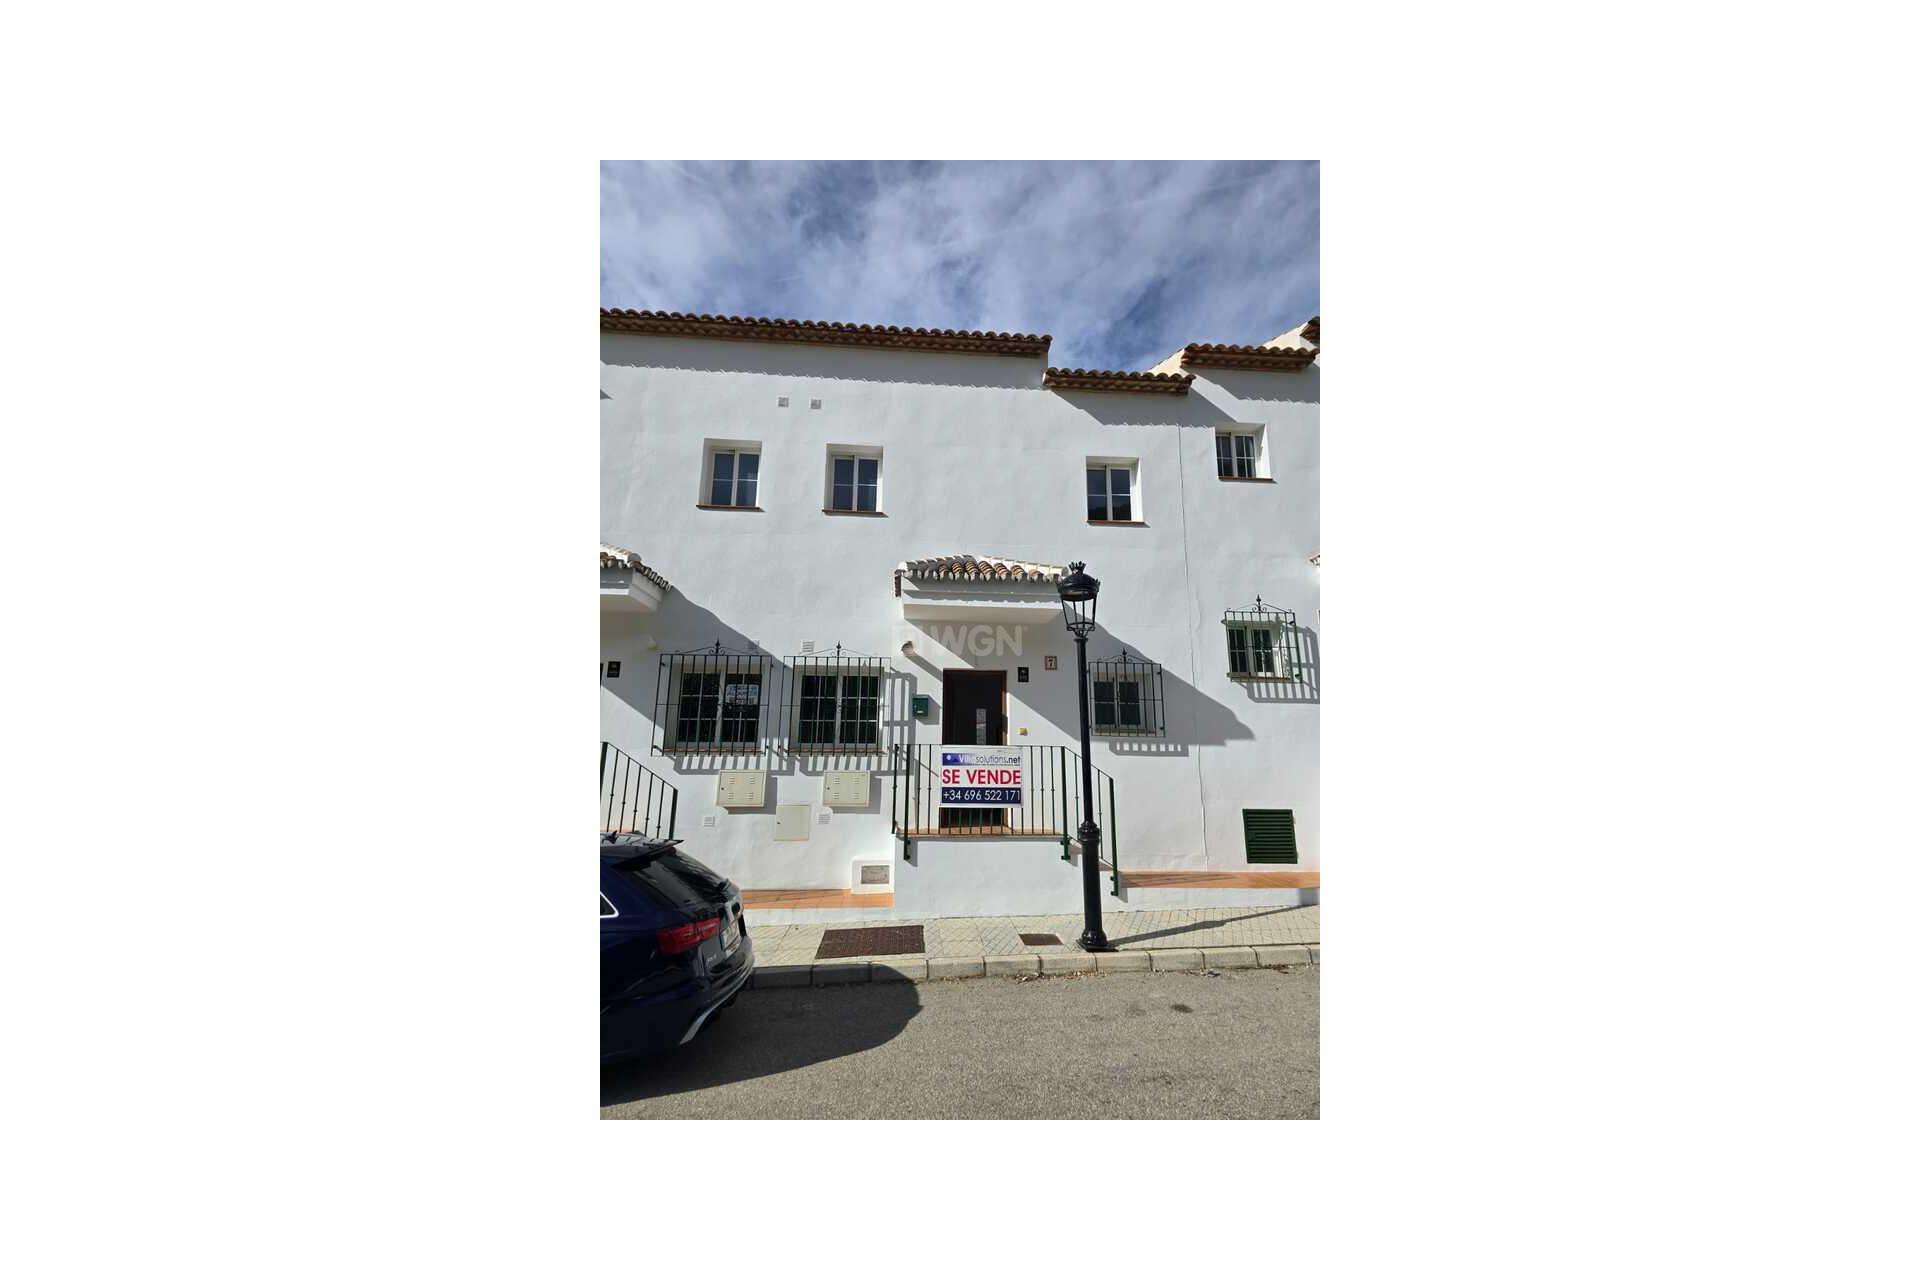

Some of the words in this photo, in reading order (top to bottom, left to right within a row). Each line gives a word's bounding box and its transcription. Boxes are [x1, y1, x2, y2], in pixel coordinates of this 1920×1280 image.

[942, 768, 960, 785] SE
[966, 769, 1021, 785] VENDE
[943, 789, 961, 801] +34
[964, 789, 982, 801] 696
[984, 790, 1002, 801] 522
[1005, 790, 1020, 801] 171
